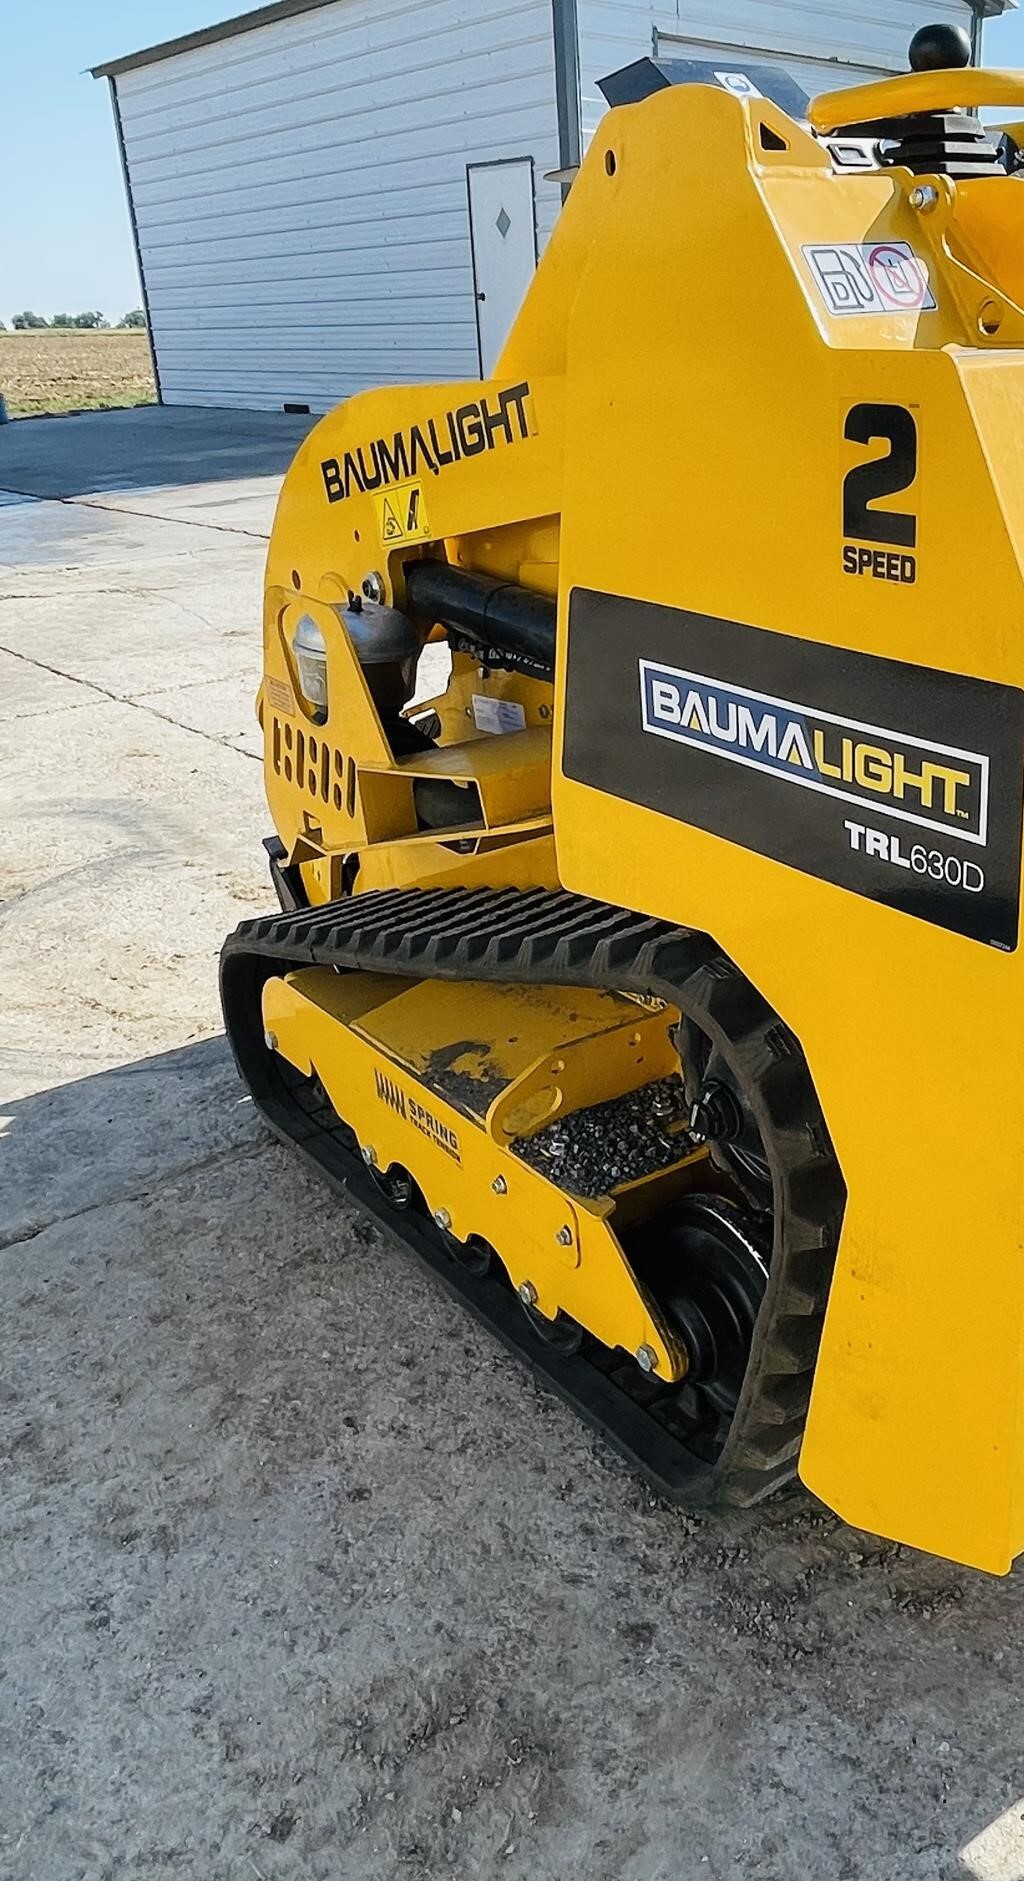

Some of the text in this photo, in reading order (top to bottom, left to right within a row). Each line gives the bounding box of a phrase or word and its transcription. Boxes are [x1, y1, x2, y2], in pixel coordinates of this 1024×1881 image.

[320, 381, 530, 504] BAUMALIGHT
[843, 402, 917, 548] 2
[843, 545, 916, 584] SPEED
[652, 679, 970, 816] BAUMALIGHT
[844, 819, 984, 893] TRL630D
[408, 1098, 458, 1150] SPRING
